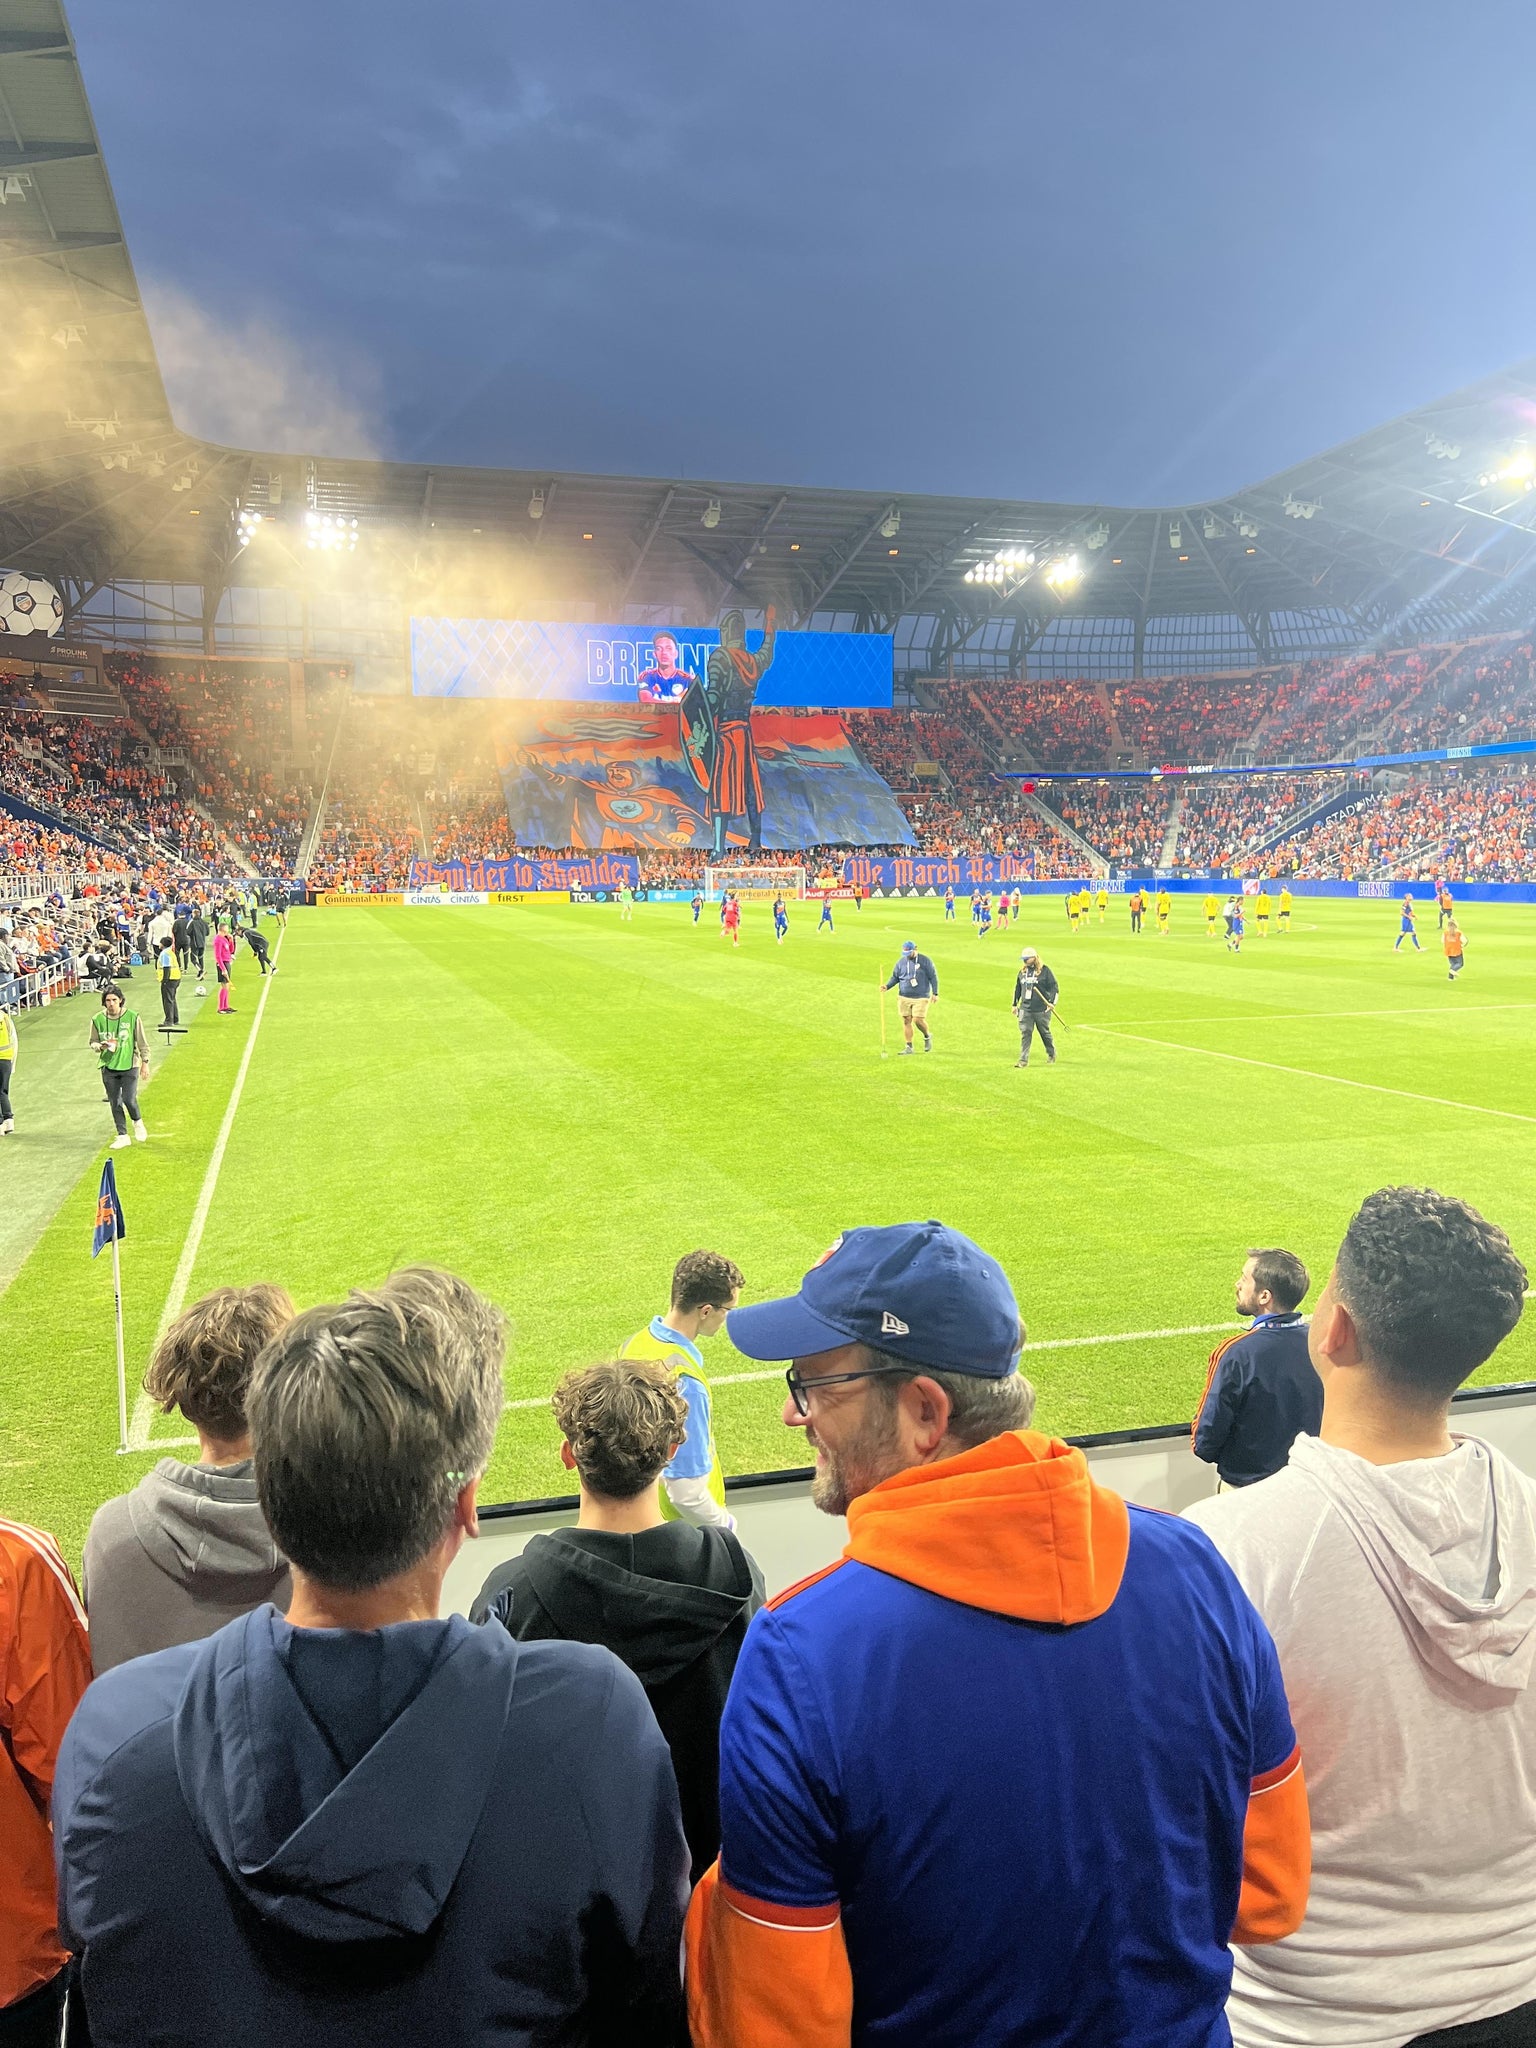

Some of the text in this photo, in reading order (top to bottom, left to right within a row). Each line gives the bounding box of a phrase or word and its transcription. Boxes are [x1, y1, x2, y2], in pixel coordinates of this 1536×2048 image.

[56, 647, 88, 657] PROLINK
[1187, 764, 1215, 774] LIGHT
[513, 860, 533, 888] to
[540, 854, 631, 890] Shoulder
[845, 857, 883, 886] We
[889, 854, 960, 887] March
[966, 858, 993, 883] As
[324, 894, 398, 905] Continental Tire
[572, 892, 595, 903] TQL
[806, 890, 825, 898] Audi
